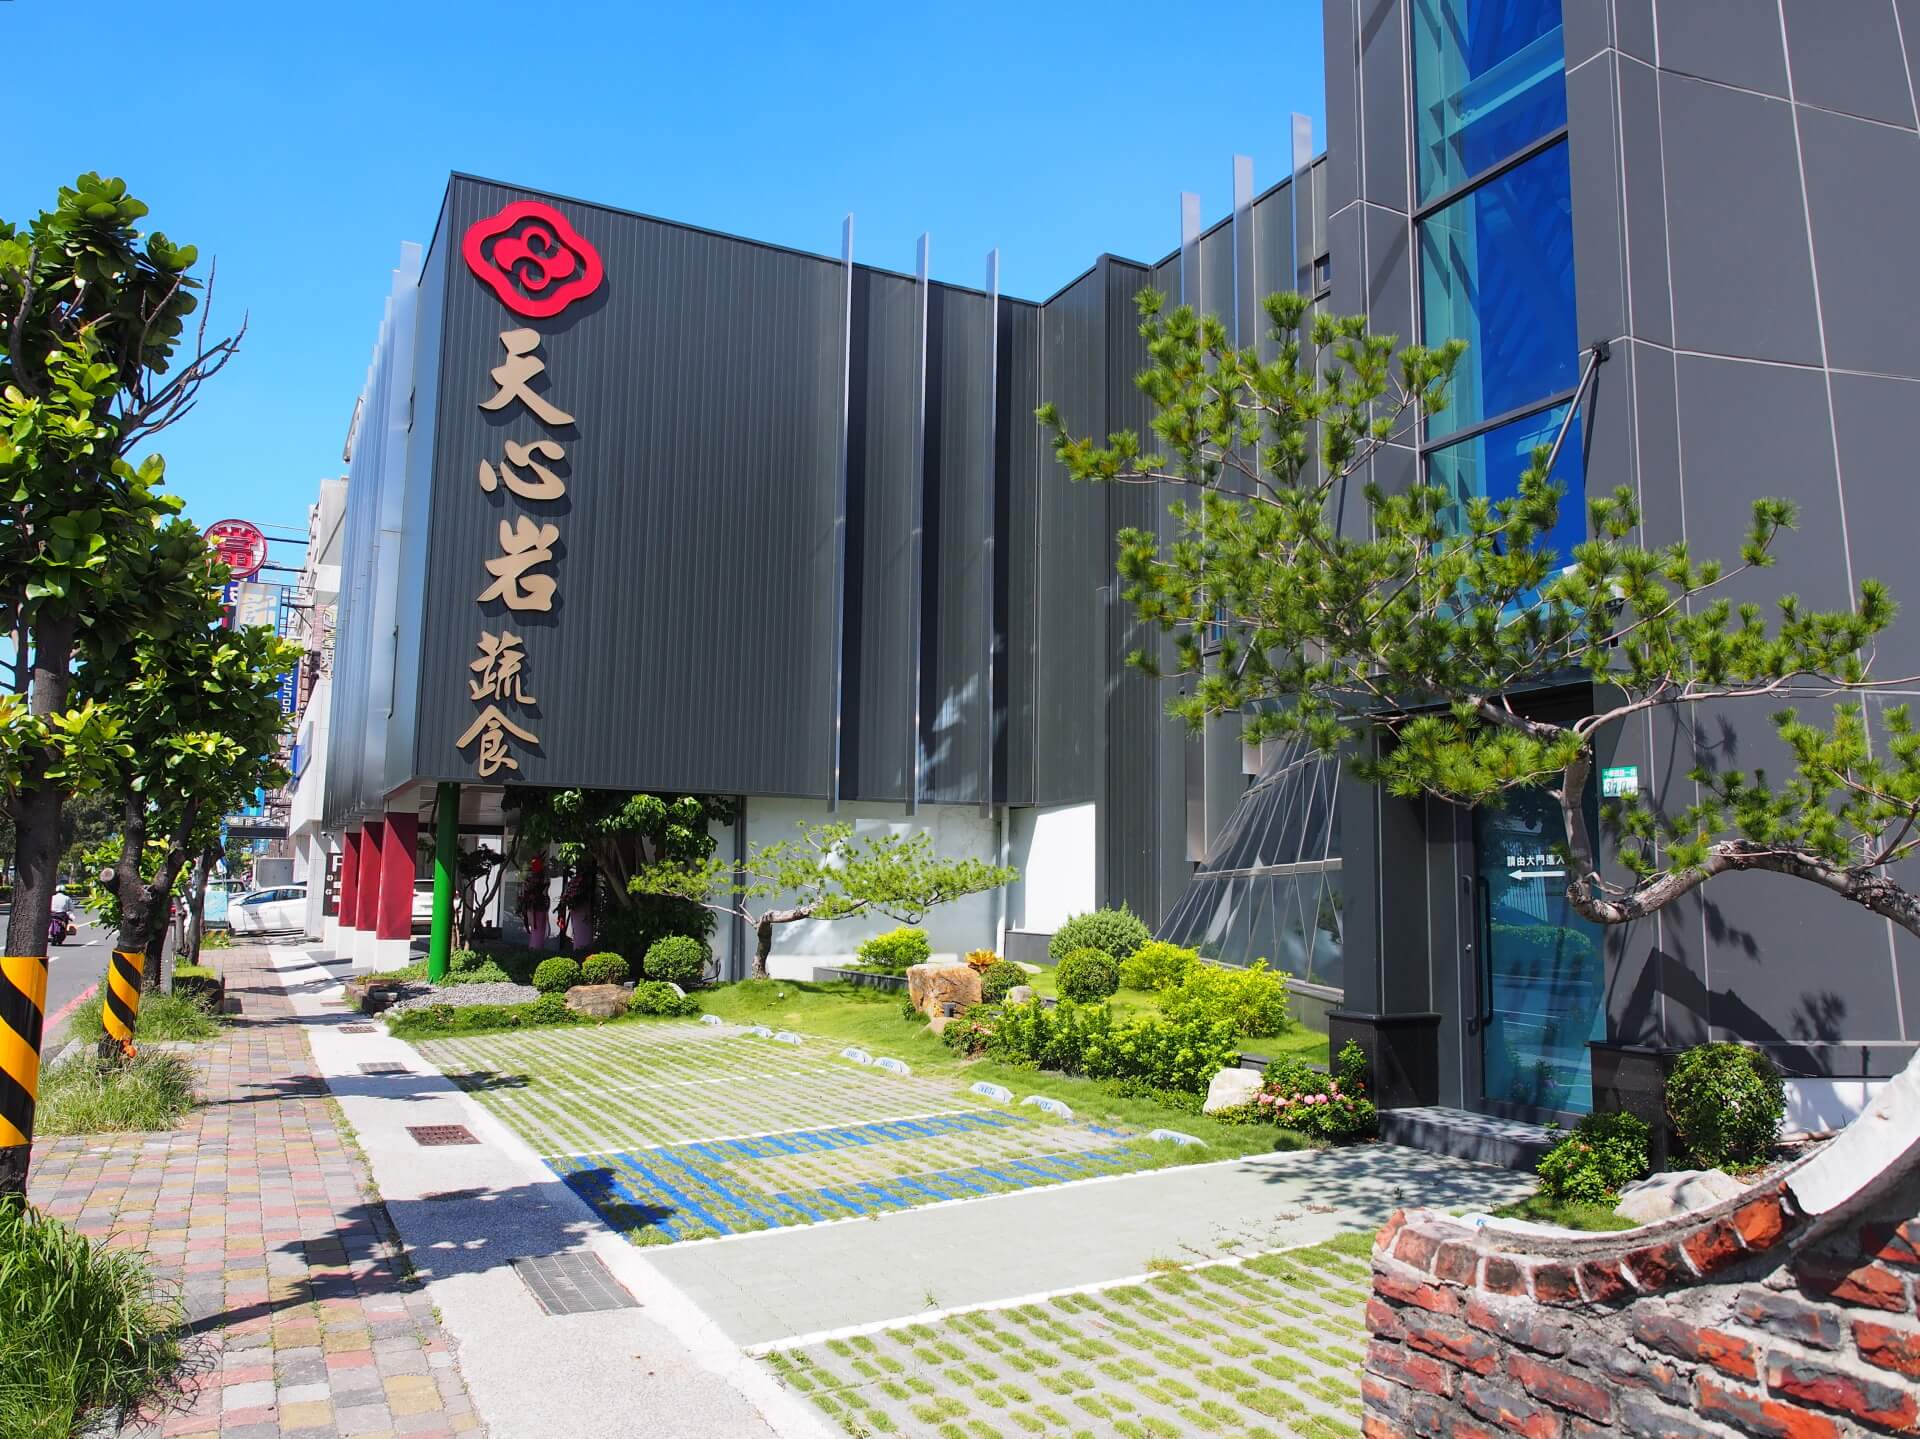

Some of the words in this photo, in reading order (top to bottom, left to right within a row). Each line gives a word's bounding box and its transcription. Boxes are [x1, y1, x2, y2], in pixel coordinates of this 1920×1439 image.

[455, 327, 576, 777] 天心岩蔬食
[1506, 854, 1566, 867] 請由大門進入
